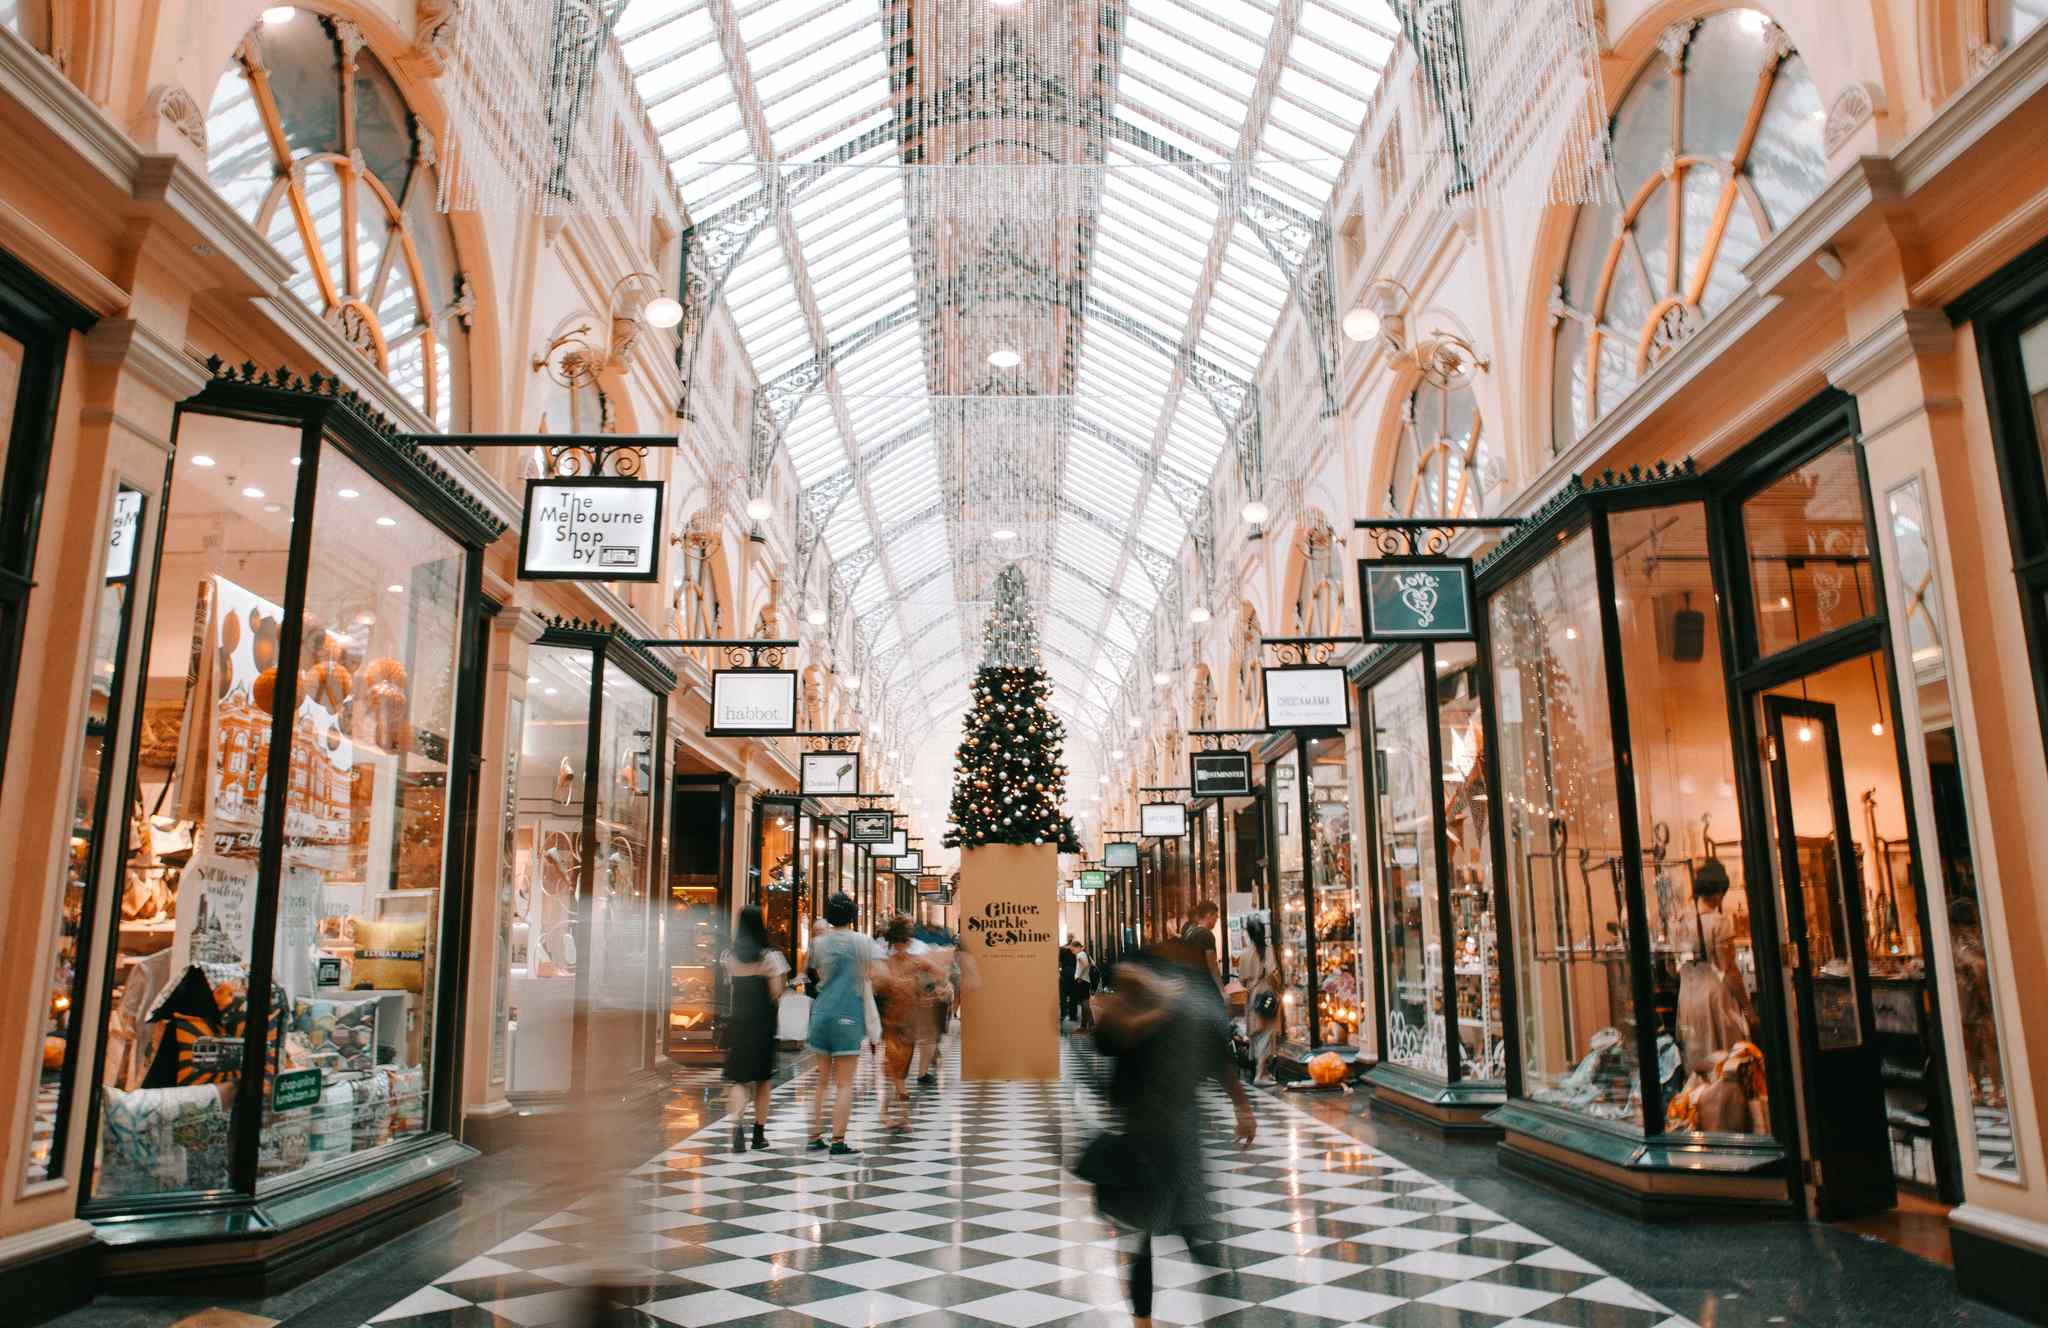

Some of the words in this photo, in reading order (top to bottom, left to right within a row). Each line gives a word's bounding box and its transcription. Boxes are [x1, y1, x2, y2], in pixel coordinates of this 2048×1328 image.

[561, 493, 593, 509] The
[540, 507, 644, 525] Melbourne
[556, 525, 604, 546] Shop
[572, 546, 596, 564] by
[985, 902, 1040, 918] Glitter.
[968, 916, 1029, 932] Sparkle
